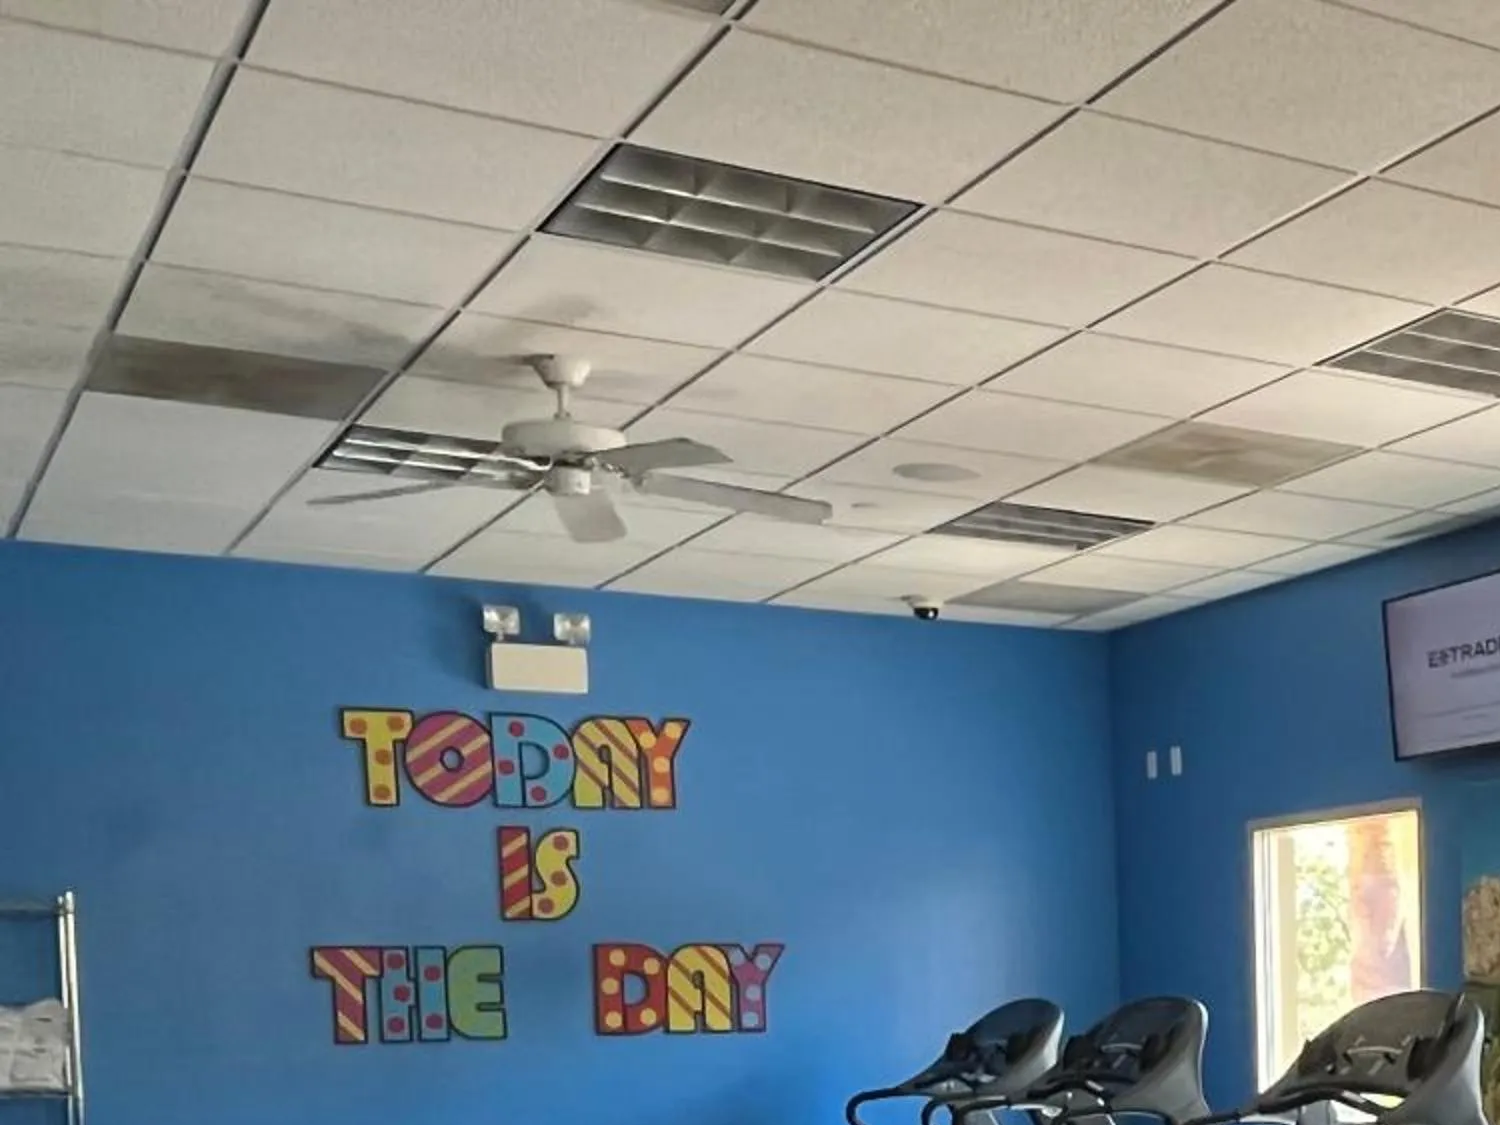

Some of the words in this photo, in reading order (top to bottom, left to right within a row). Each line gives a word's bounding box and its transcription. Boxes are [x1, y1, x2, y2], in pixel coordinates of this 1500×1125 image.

[340, 708, 690, 808] TODAY
[497, 827, 579, 920] IS
[310, 946, 507, 1045] THE
[592, 943, 785, 1034] DAY
